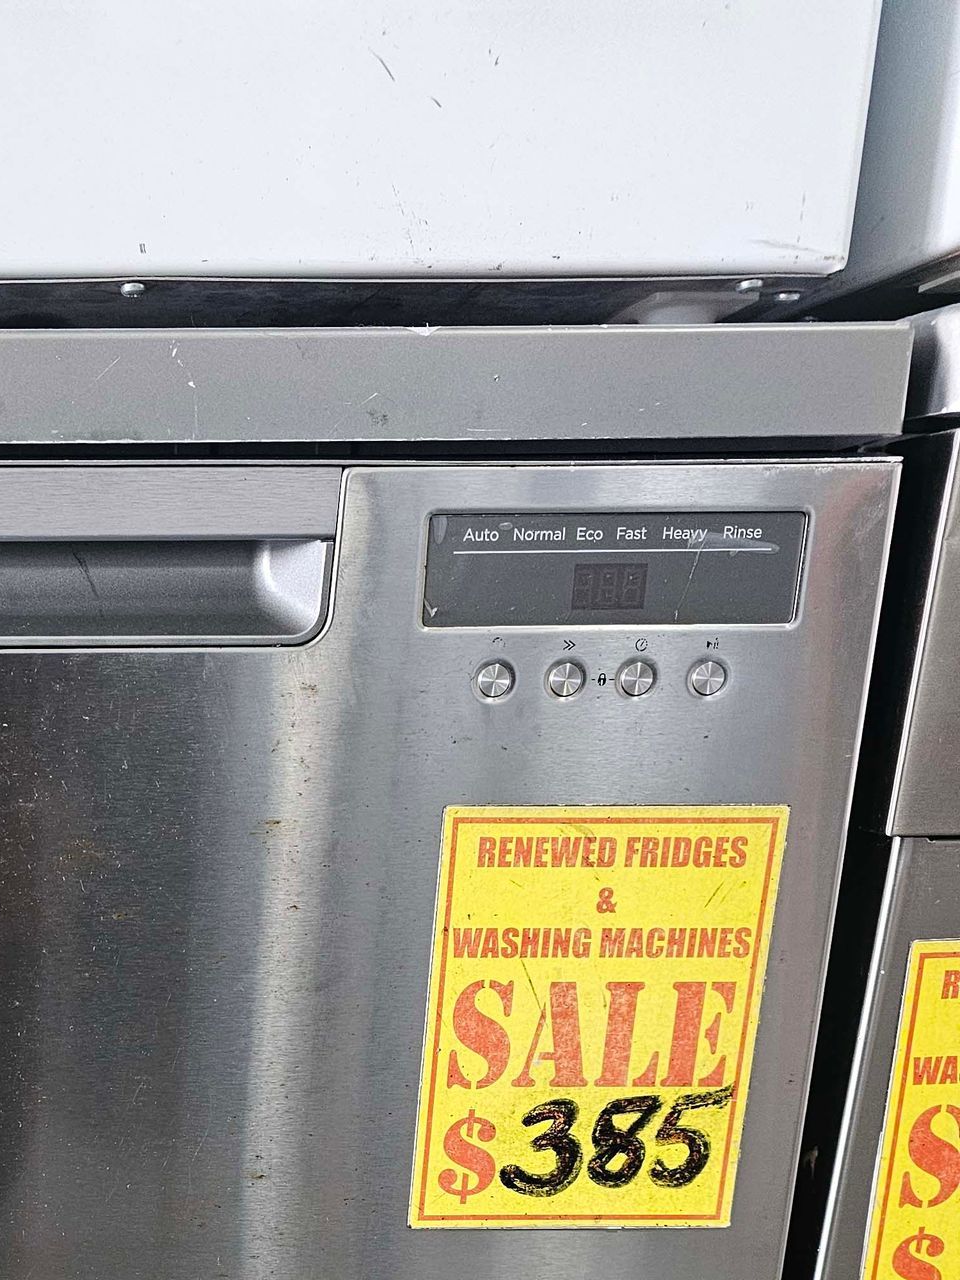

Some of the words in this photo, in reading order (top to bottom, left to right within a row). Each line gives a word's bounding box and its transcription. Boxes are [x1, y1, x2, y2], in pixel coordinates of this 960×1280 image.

[463, 528, 499, 542] Auto
[513, 527, 566, 541] Normal
[576, 527, 603, 541] Eco
[616, 526, 647, 540] Fast
[662, 526, 707, 543] Heavy
[723, 525, 762, 539] Rinse
[477, 836, 618, 868] RENEWED
[624, 836, 748, 868] FRIDGES
[596, 887, 618, 914] &
[453, 927, 592, 958] WASHING
[599, 928, 752, 958] MACHINES
[447, 979, 738, 1090] SALE
